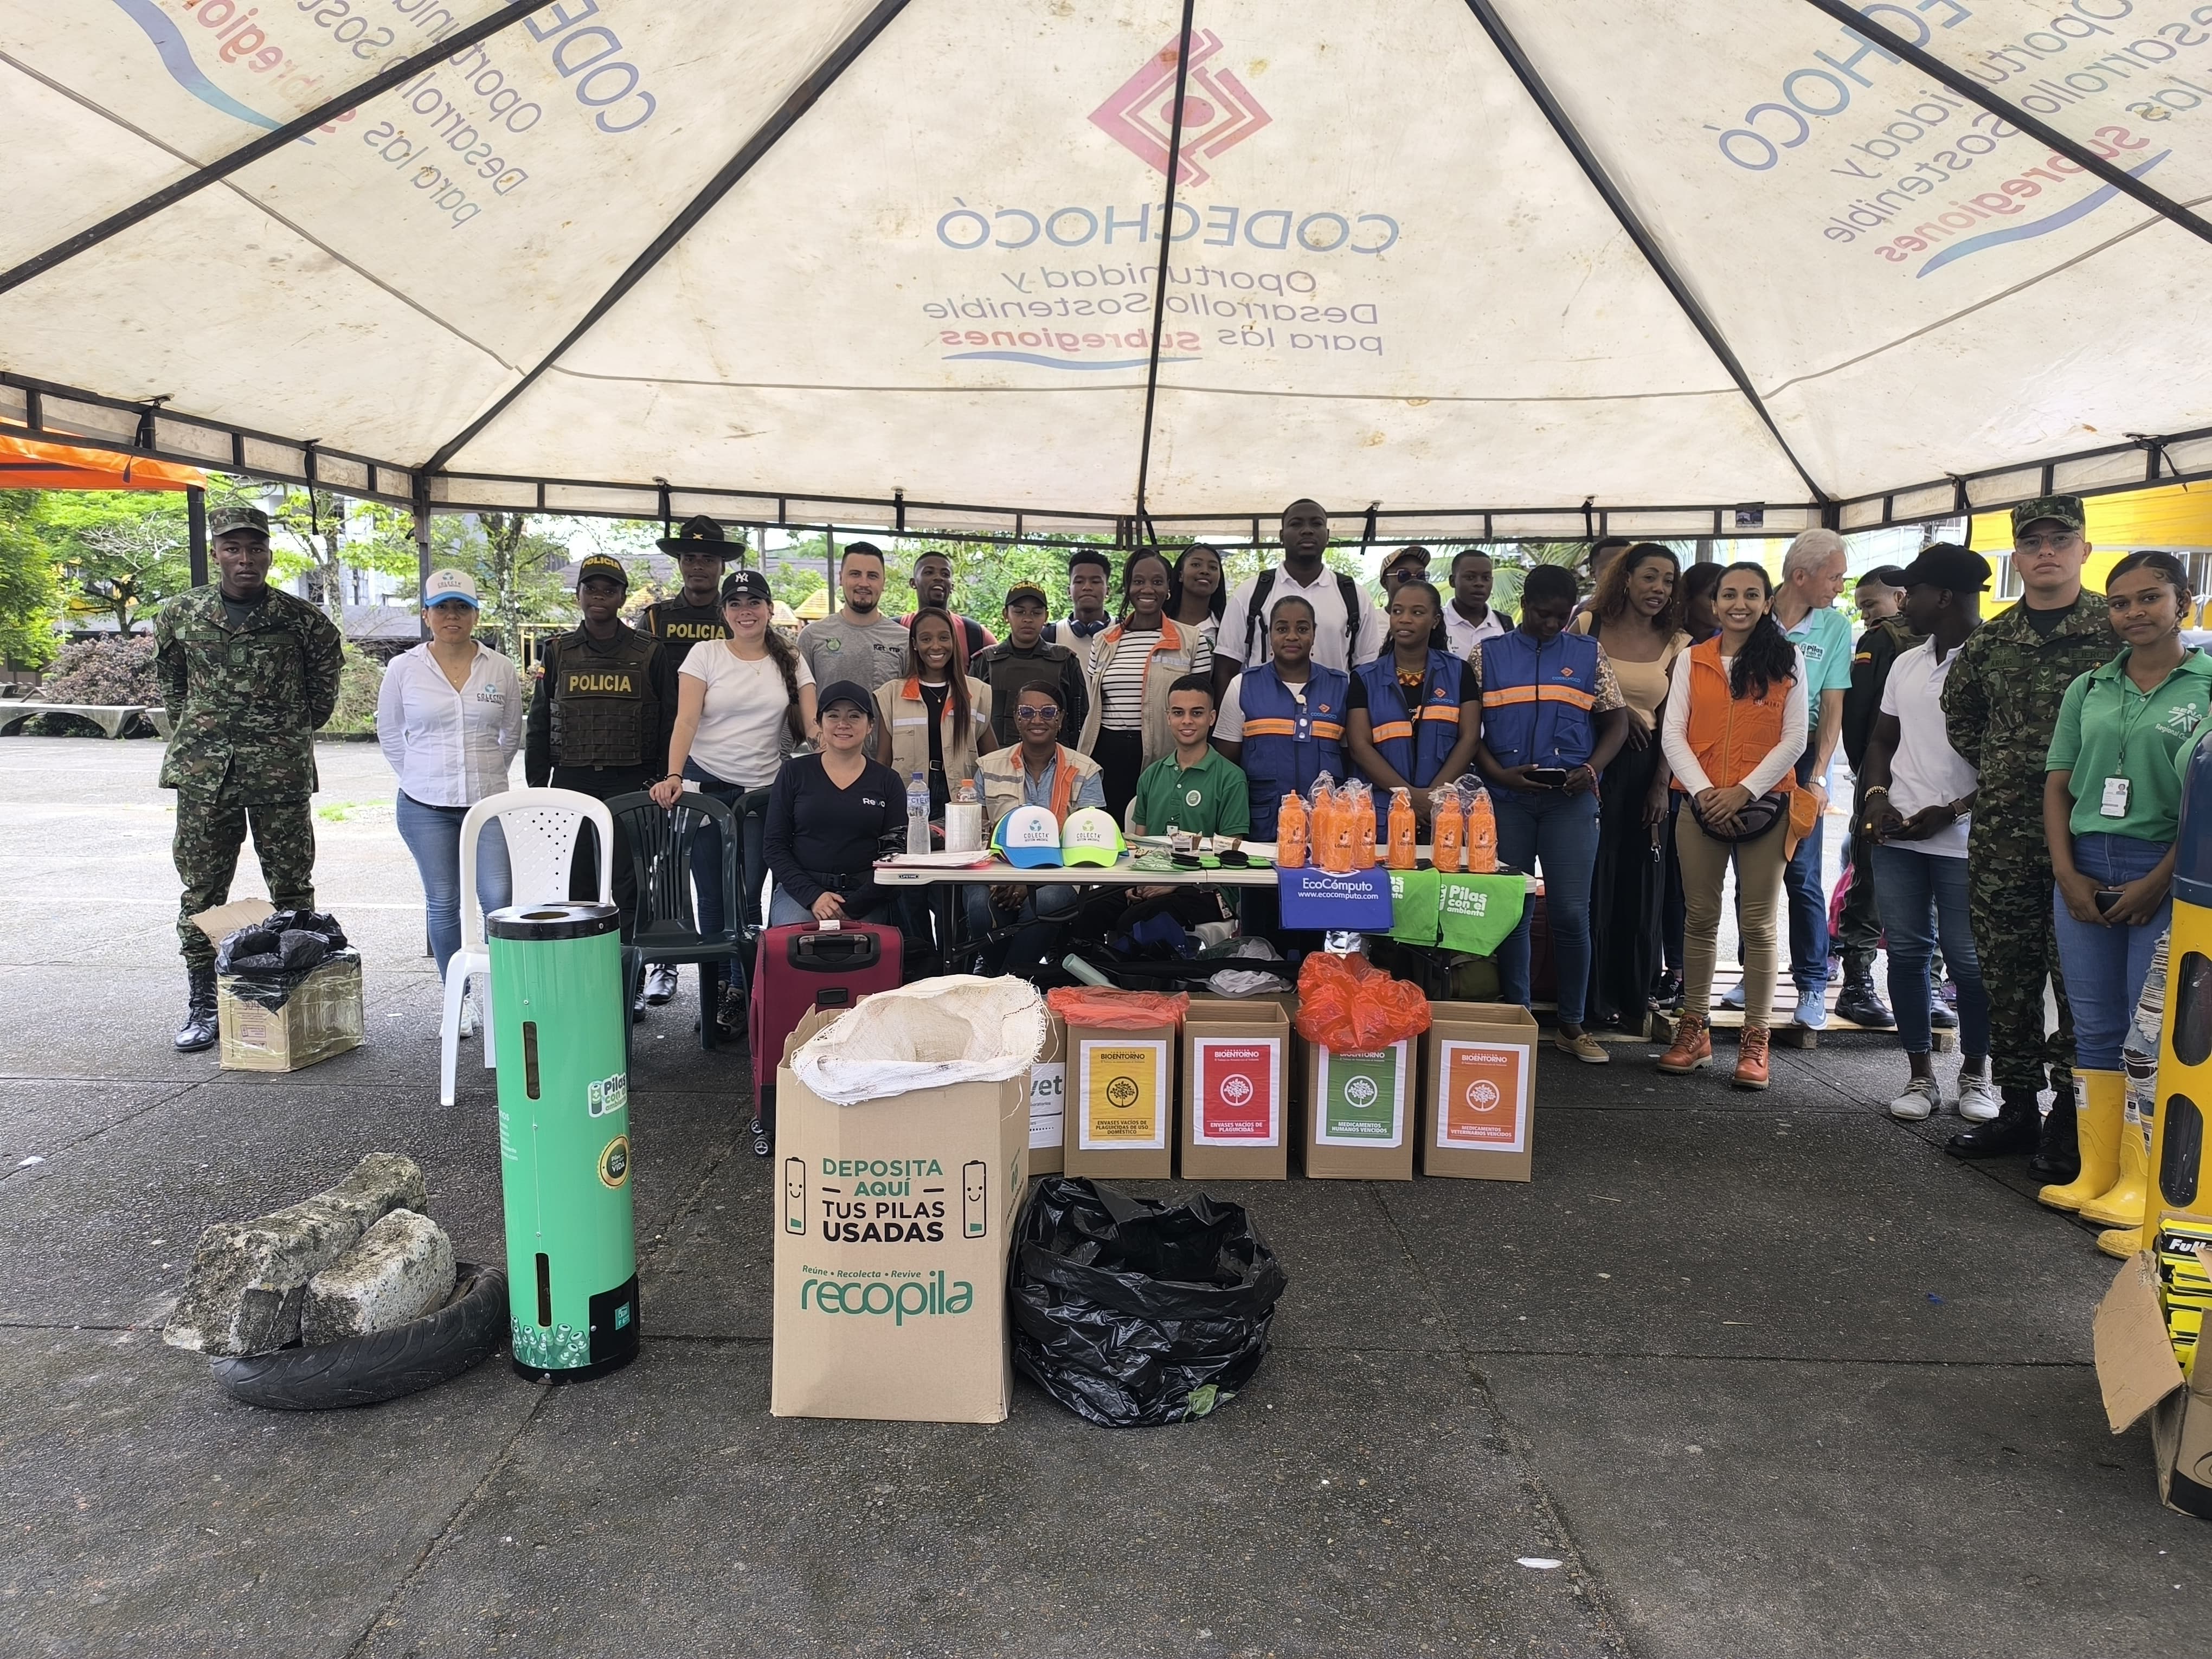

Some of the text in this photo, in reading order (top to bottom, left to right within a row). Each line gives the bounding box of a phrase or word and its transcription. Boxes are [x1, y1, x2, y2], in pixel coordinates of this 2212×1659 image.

[582, 556, 621, 570] POLICIA
[666, 624, 726, 640] POLICIA
[569, 675, 632, 692] POLICIA
[2171, 706, 2202, 721] SENA
[2155, 723, 2179, 737] Regional
[1302, 878, 1373, 894] EcoCómputo
[1297, 891, 1379, 900] www.ecocomputo.com
[1449, 885, 1488, 904] Pilas
[1446, 906, 1485, 917] ambiente
[1448, 898, 1486, 911] con el
[1461, 1054, 1508, 1063] BIOENTORNO
[603, 1075, 626, 1096] Pilas
[605, 1091, 621, 1104] con
[612, 1162, 625, 1173] VIDA
[822, 1158, 943, 1177] DEPOSITA
[854, 1178, 911, 1197] AQUÍ
[822, 1200, 946, 1219] TUS PILAS
[822, 1220, 944, 1243] USADAS
[802, 1265, 828, 1276] Reúne
[837, 1270, 882, 1278] Recolecta
[801, 1270, 973, 1326] recopila
